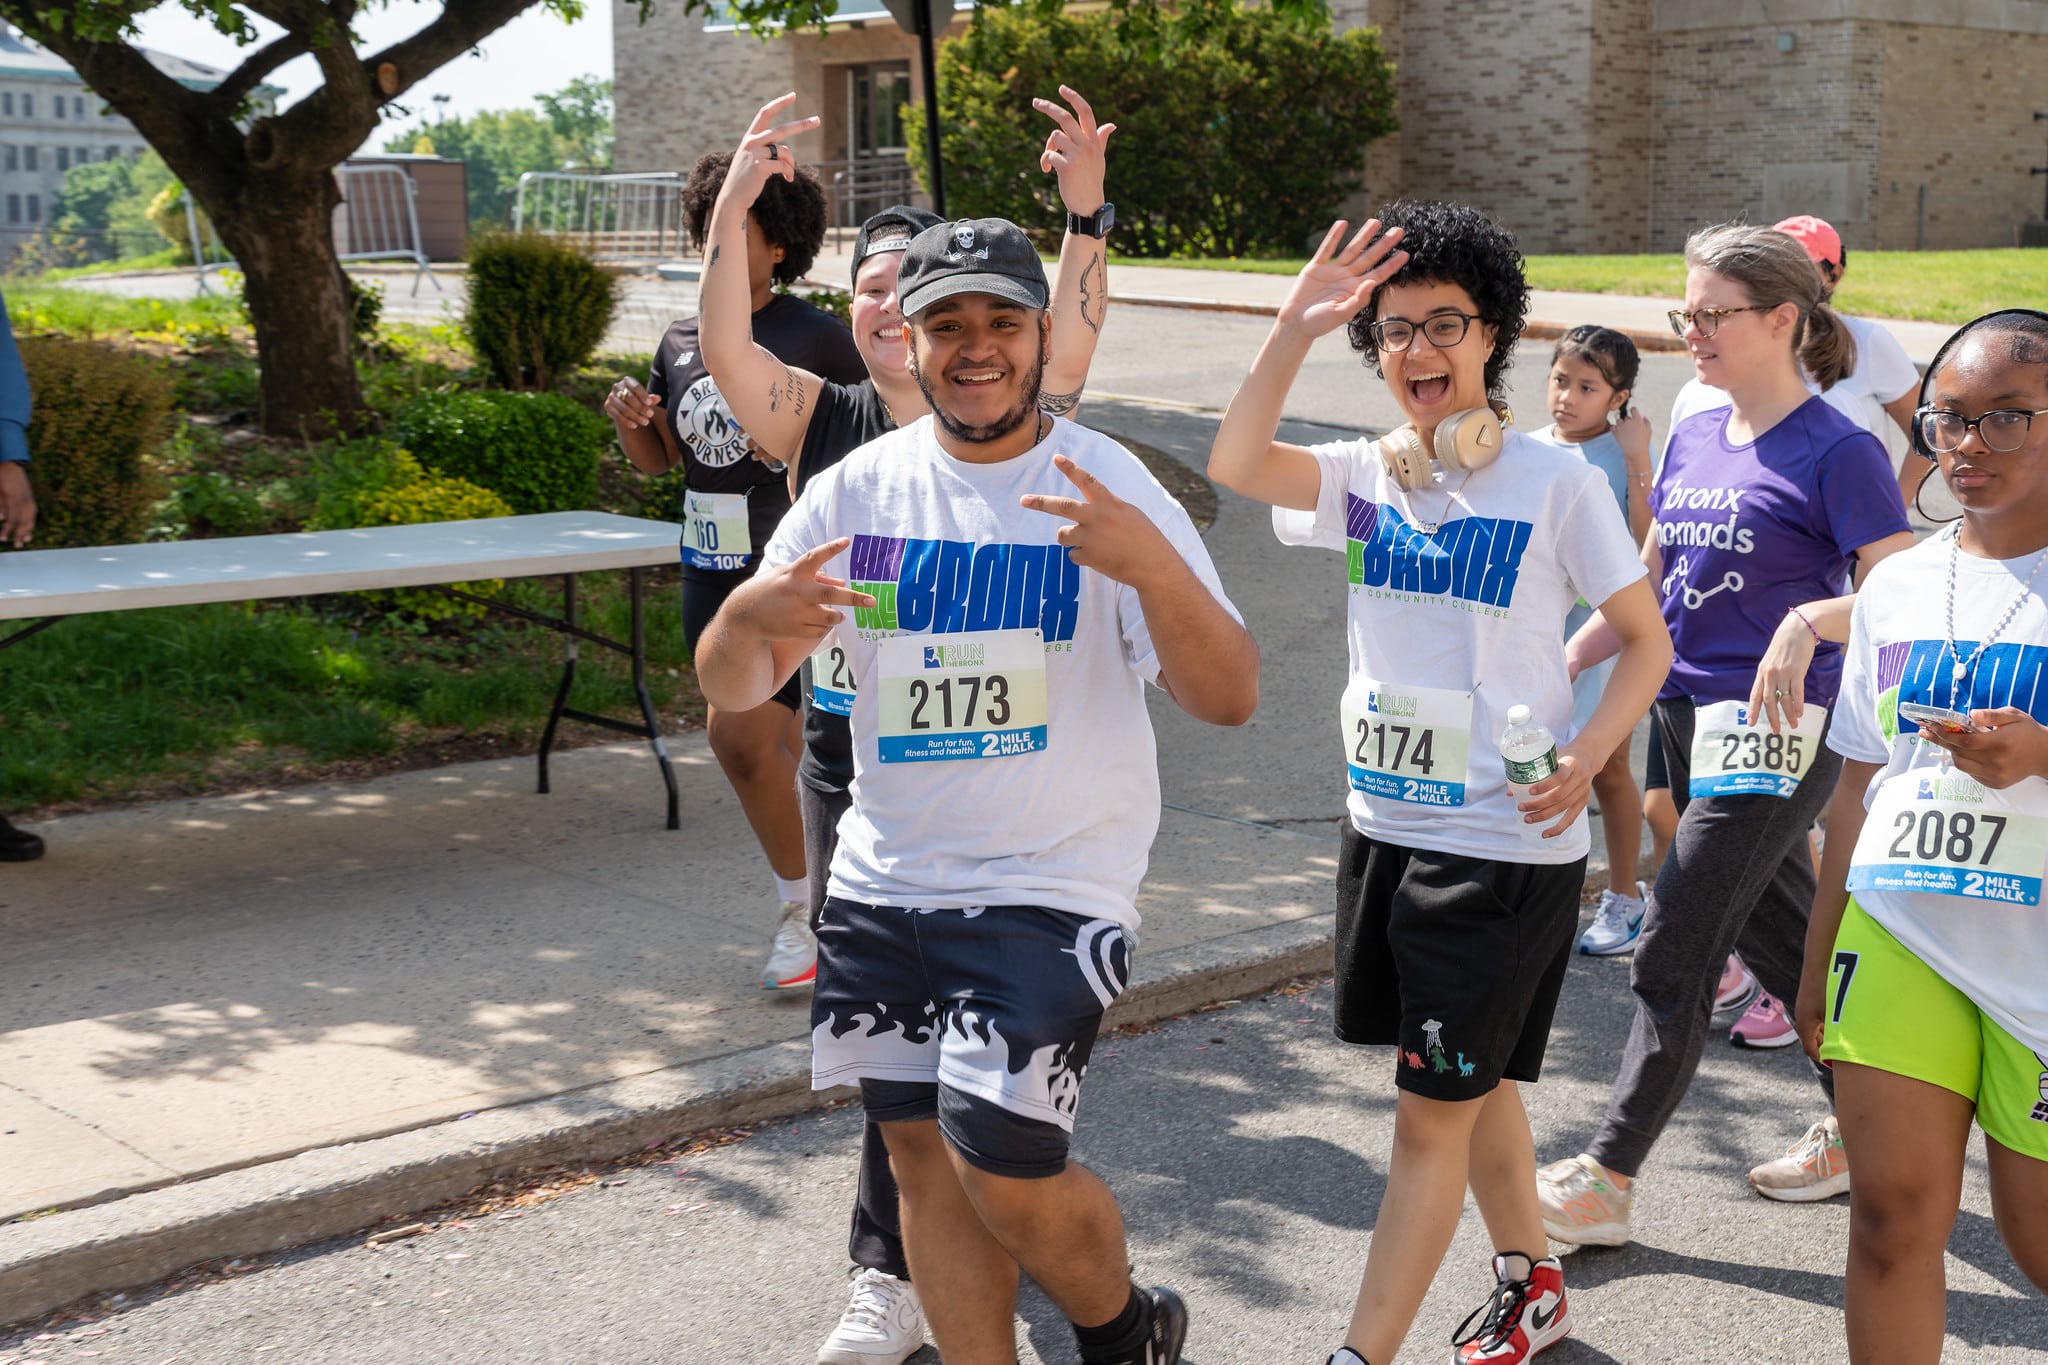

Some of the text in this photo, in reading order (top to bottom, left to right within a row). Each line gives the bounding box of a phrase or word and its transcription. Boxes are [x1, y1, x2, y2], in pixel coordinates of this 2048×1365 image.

[1663, 479, 1747, 513] bronx
[1656, 514, 1755, 554] nomads
[713, 555, 747, 570] 10K
[849, 534, 907, 581] RUN
[1363, 503, 1533, 609] BRONX
[897, 537, 1080, 643] BRONX
[1367, 588, 1446, 606] COMMUNITY
[1451, 599, 1510, 620] COLLEGE
[944, 643, 985, 660] RUN
[945, 659, 985, 668] THEBRONX
[910, 675, 1011, 729] 2173
[1382, 694, 1418, 711] RUN
[927, 740, 943, 748] Run
[945, 739, 957, 747] for
[981, 733, 1000, 757] 2
[1000, 731, 1031, 745] MILE
[1355, 718, 1434, 775] 2174
[905, 746, 976, 757] fitness and health!
[1001, 740, 1035, 755] WALK
[1722, 732, 1803, 774] 2385
[1376, 777, 1385, 786] for
[1402, 779, 1419, 801] 2
[1420, 783, 1448, 795] MILE
[1941, 778, 1986, 797] RUN
[1419, 792, 1452, 805] WALK
[1888, 809, 2007, 866] 2087
[1904, 869, 1922, 879] Run
[1923, 871, 1938, 880] for
[1905, 877, 1923, 887] and
[1986, 875, 2021, 890] MILE
[1962, 872, 1985, 897] 2
[1985, 886, 2026, 903] WALK
[1832, 950, 1860, 1025] 7
